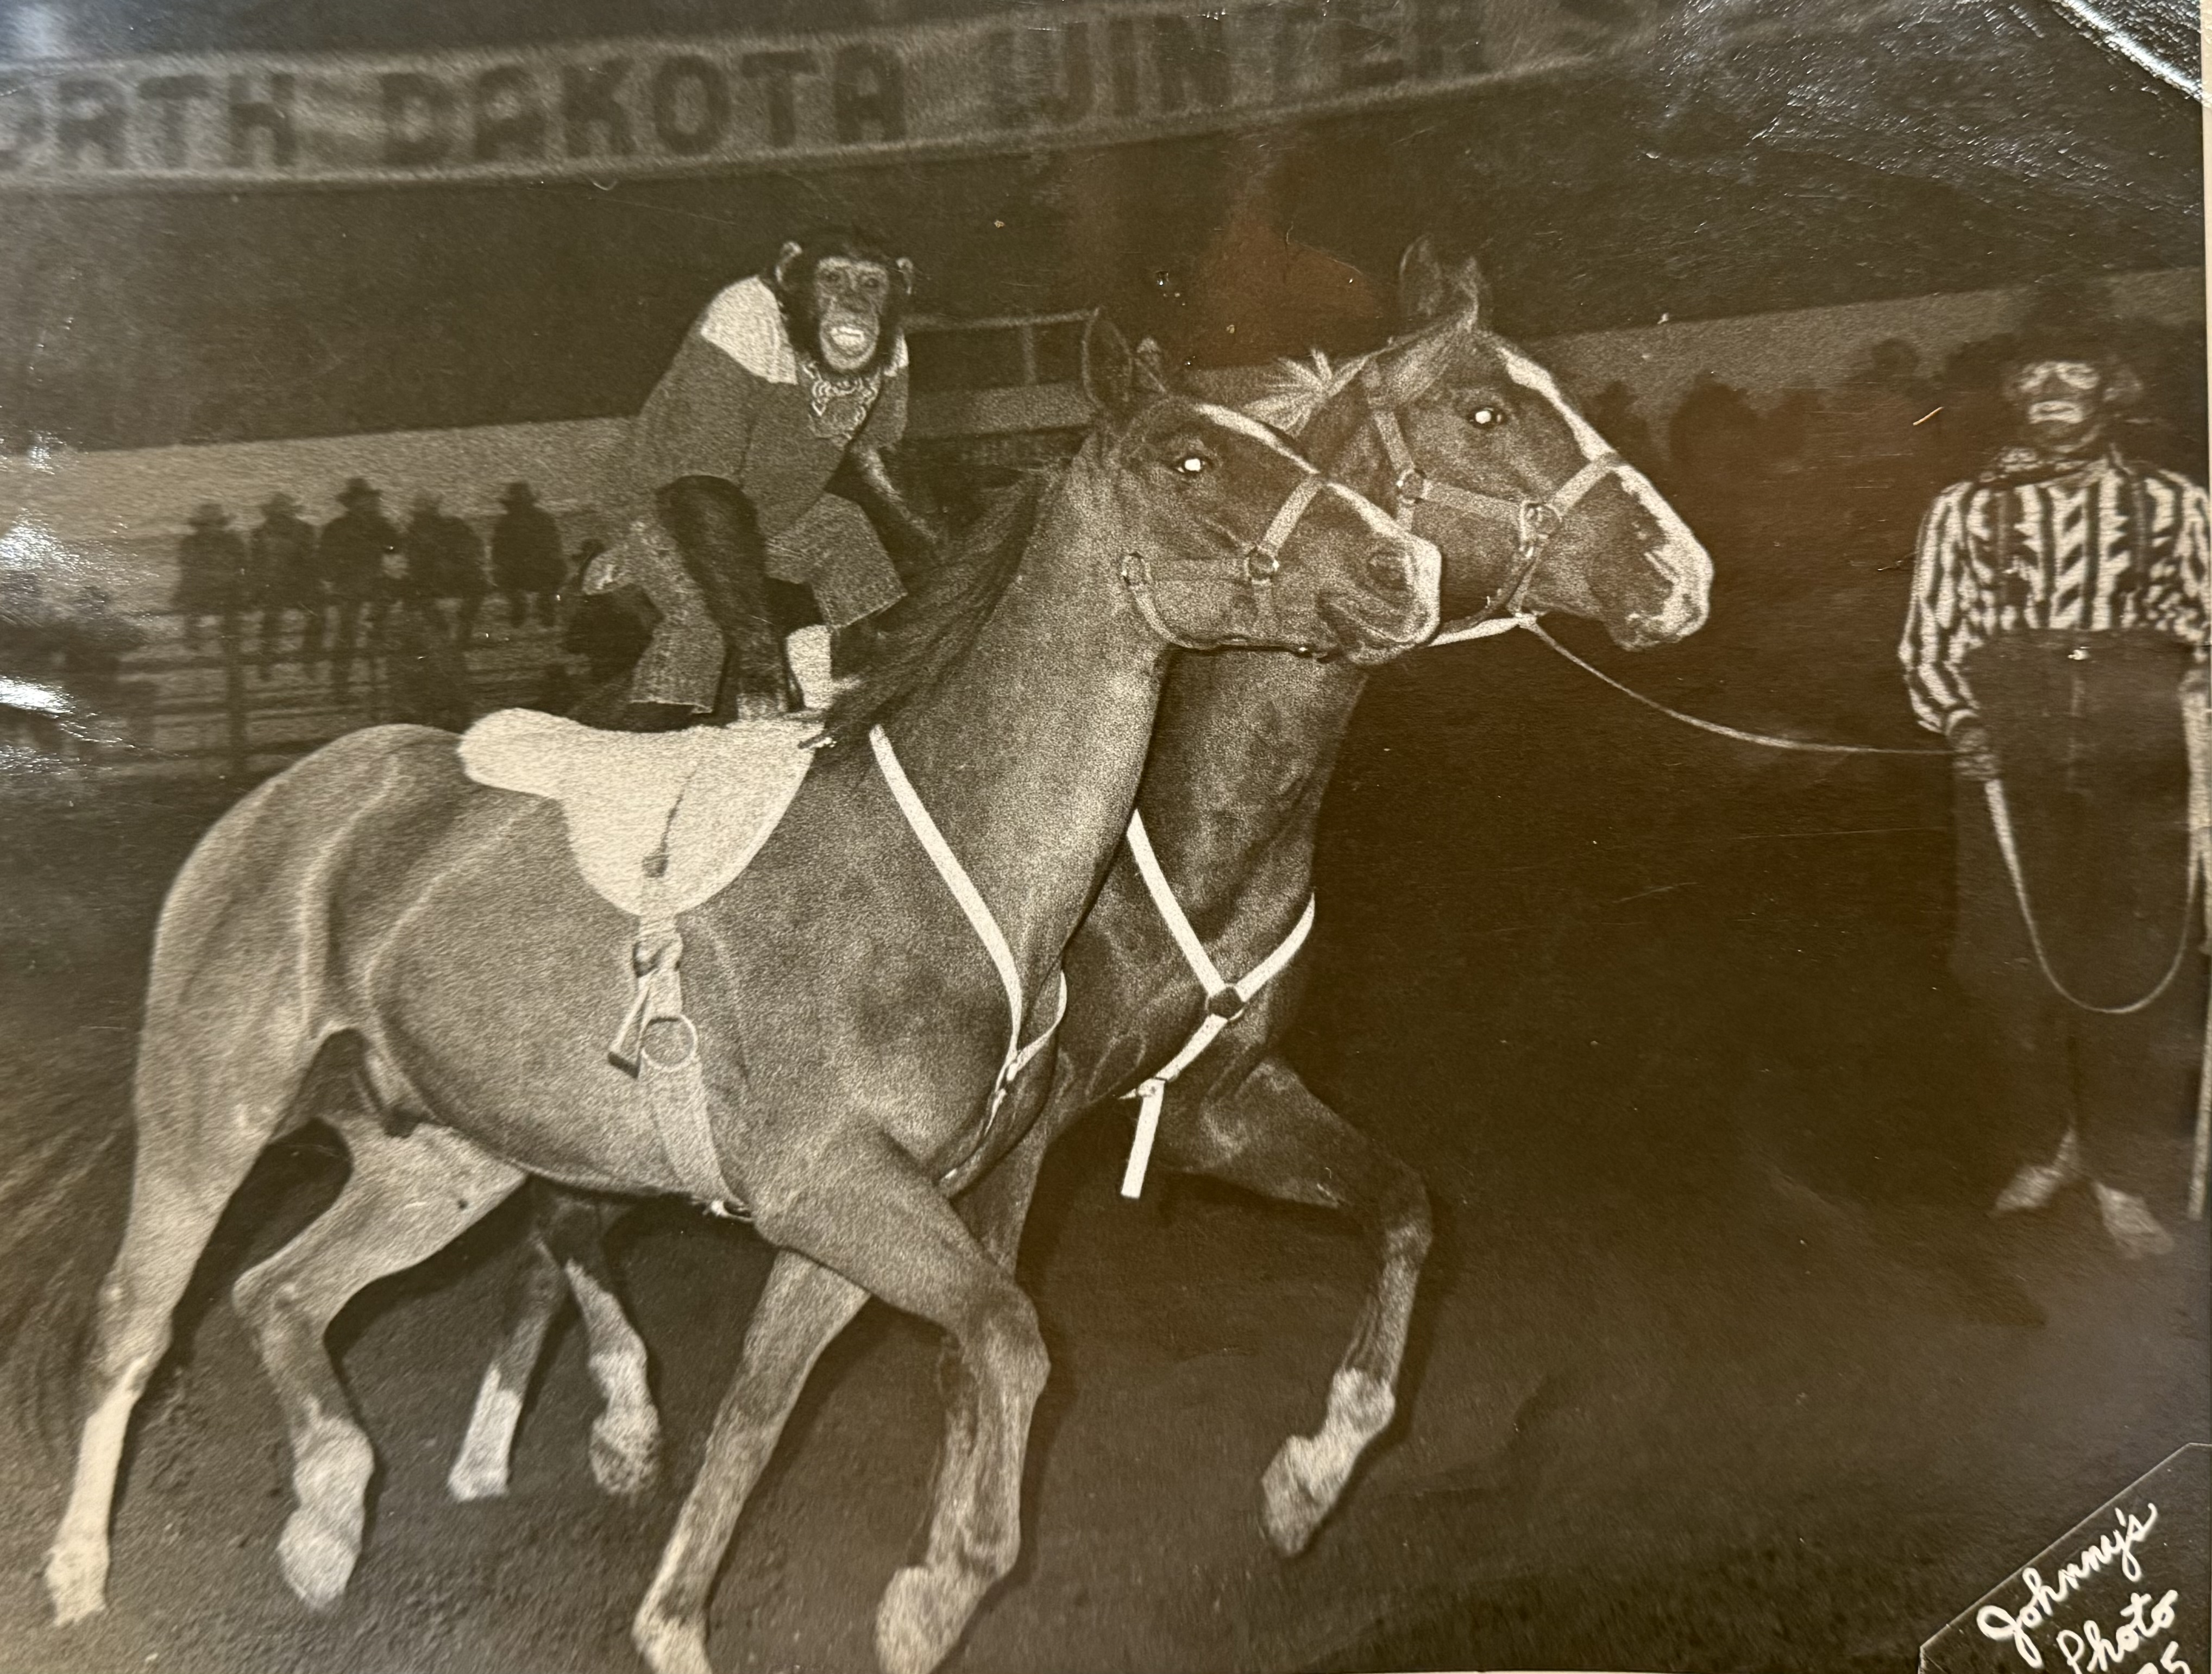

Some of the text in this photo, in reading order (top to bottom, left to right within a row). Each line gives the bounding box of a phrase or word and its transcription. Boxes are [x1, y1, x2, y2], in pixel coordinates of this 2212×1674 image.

[380, 43, 906, 166] DAKOTA
[1976, 1503, 2158, 1669] Johnny's
[2056, 1589, 2178, 1674] Photo
